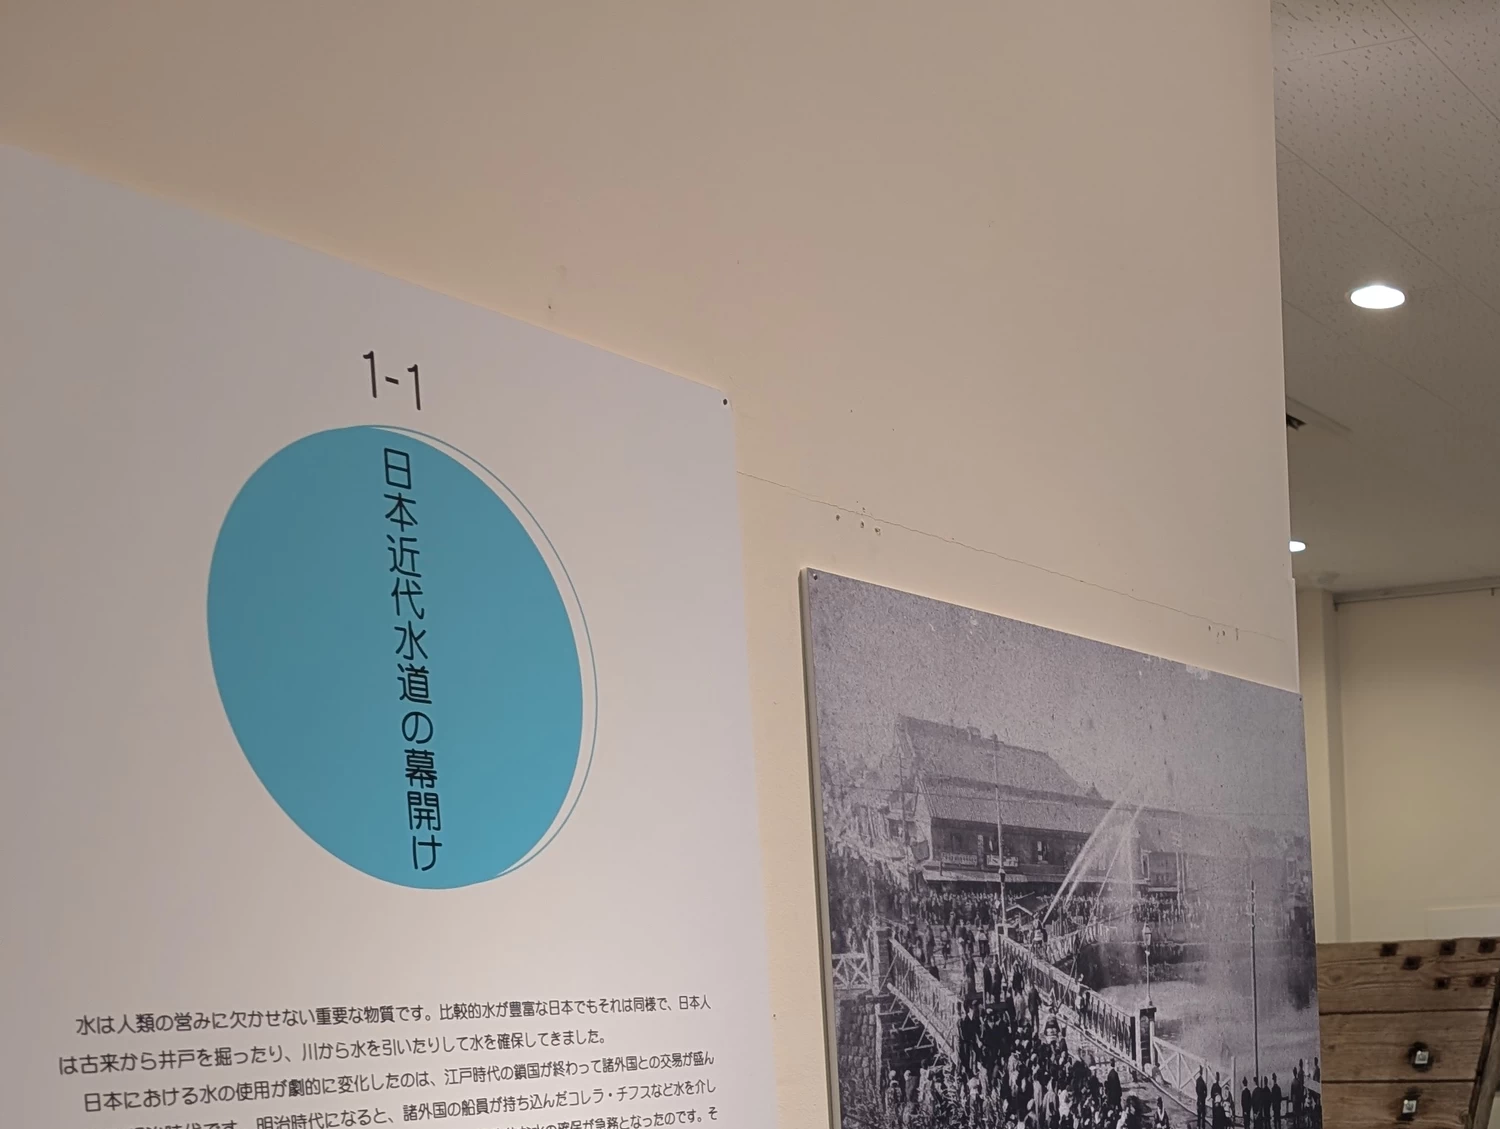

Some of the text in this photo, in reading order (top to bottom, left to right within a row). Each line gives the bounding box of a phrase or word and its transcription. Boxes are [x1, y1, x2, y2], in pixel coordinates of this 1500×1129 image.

[363, 351, 421, 411] 1-1
[383, 447, 443, 872] 日本近代水道の幕開け
[76, 995, 711, 1035] 水は人類の営みに欠かせない重要な物質です。比較的水が豊富な日本でもそれは同様で、日本人
[59, 1029, 604, 1075] は古来から井戸を掘ったり、川から水を引いたりして水を確保してきました。
[84, 1051, 714, 1112] 日本における水の使用が劇的に変化したのは、江戸時代の鎖国が終わって諸外国との交易が盛ん
